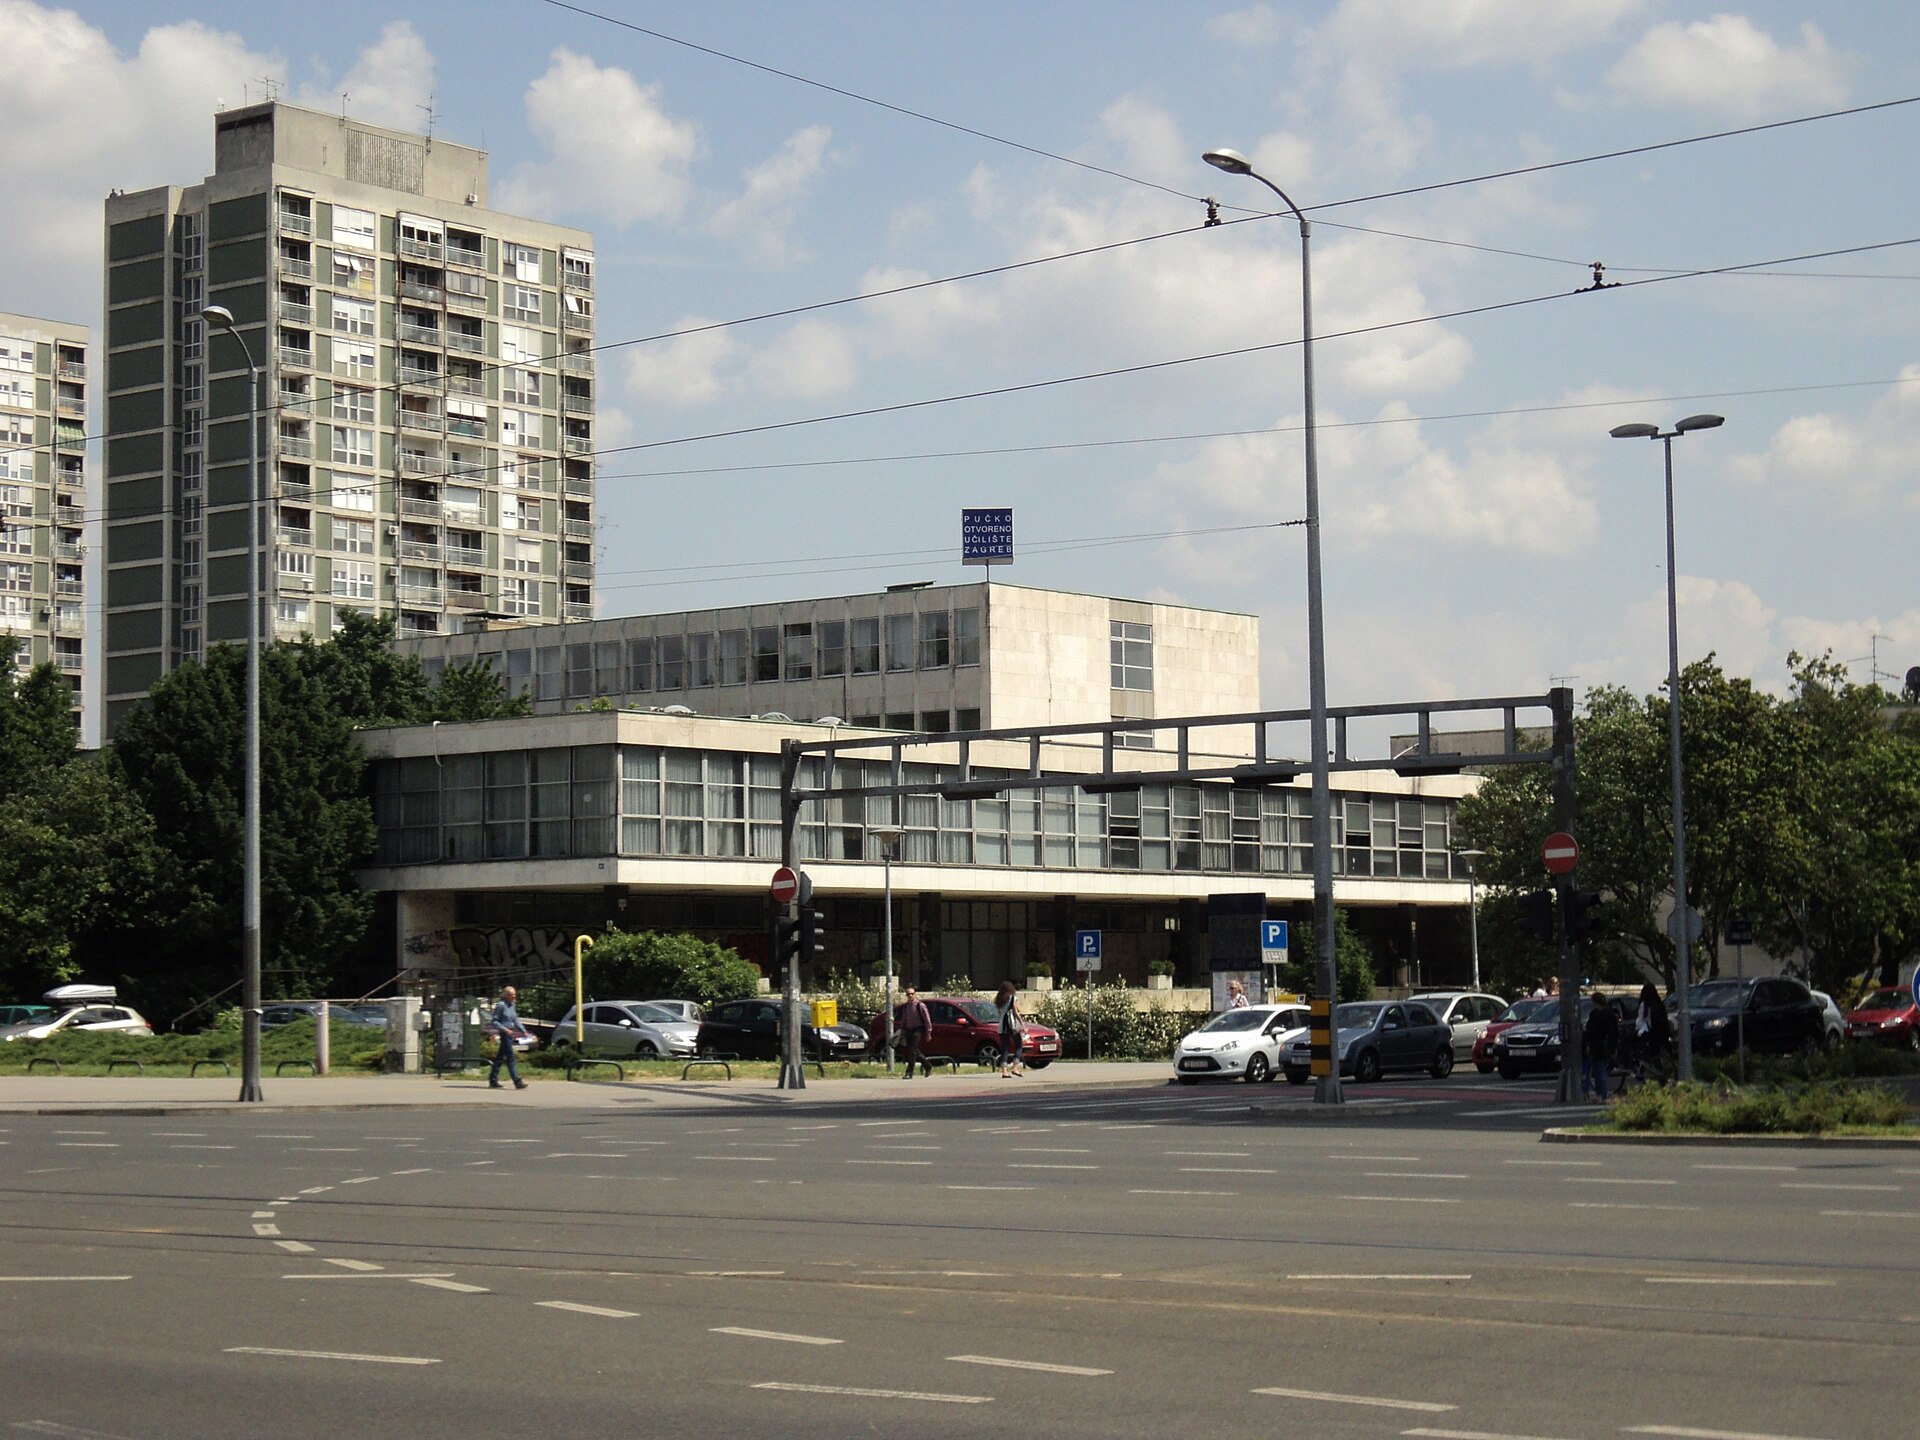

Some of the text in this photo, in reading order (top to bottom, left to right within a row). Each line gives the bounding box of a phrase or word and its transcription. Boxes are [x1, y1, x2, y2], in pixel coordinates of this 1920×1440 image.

[964, 514, 1011, 522] PUČKO
[964, 535, 1011, 543] UČILIŠTE
[1268, 925, 1281, 943] P
[1083, 935, 1094, 952] P
